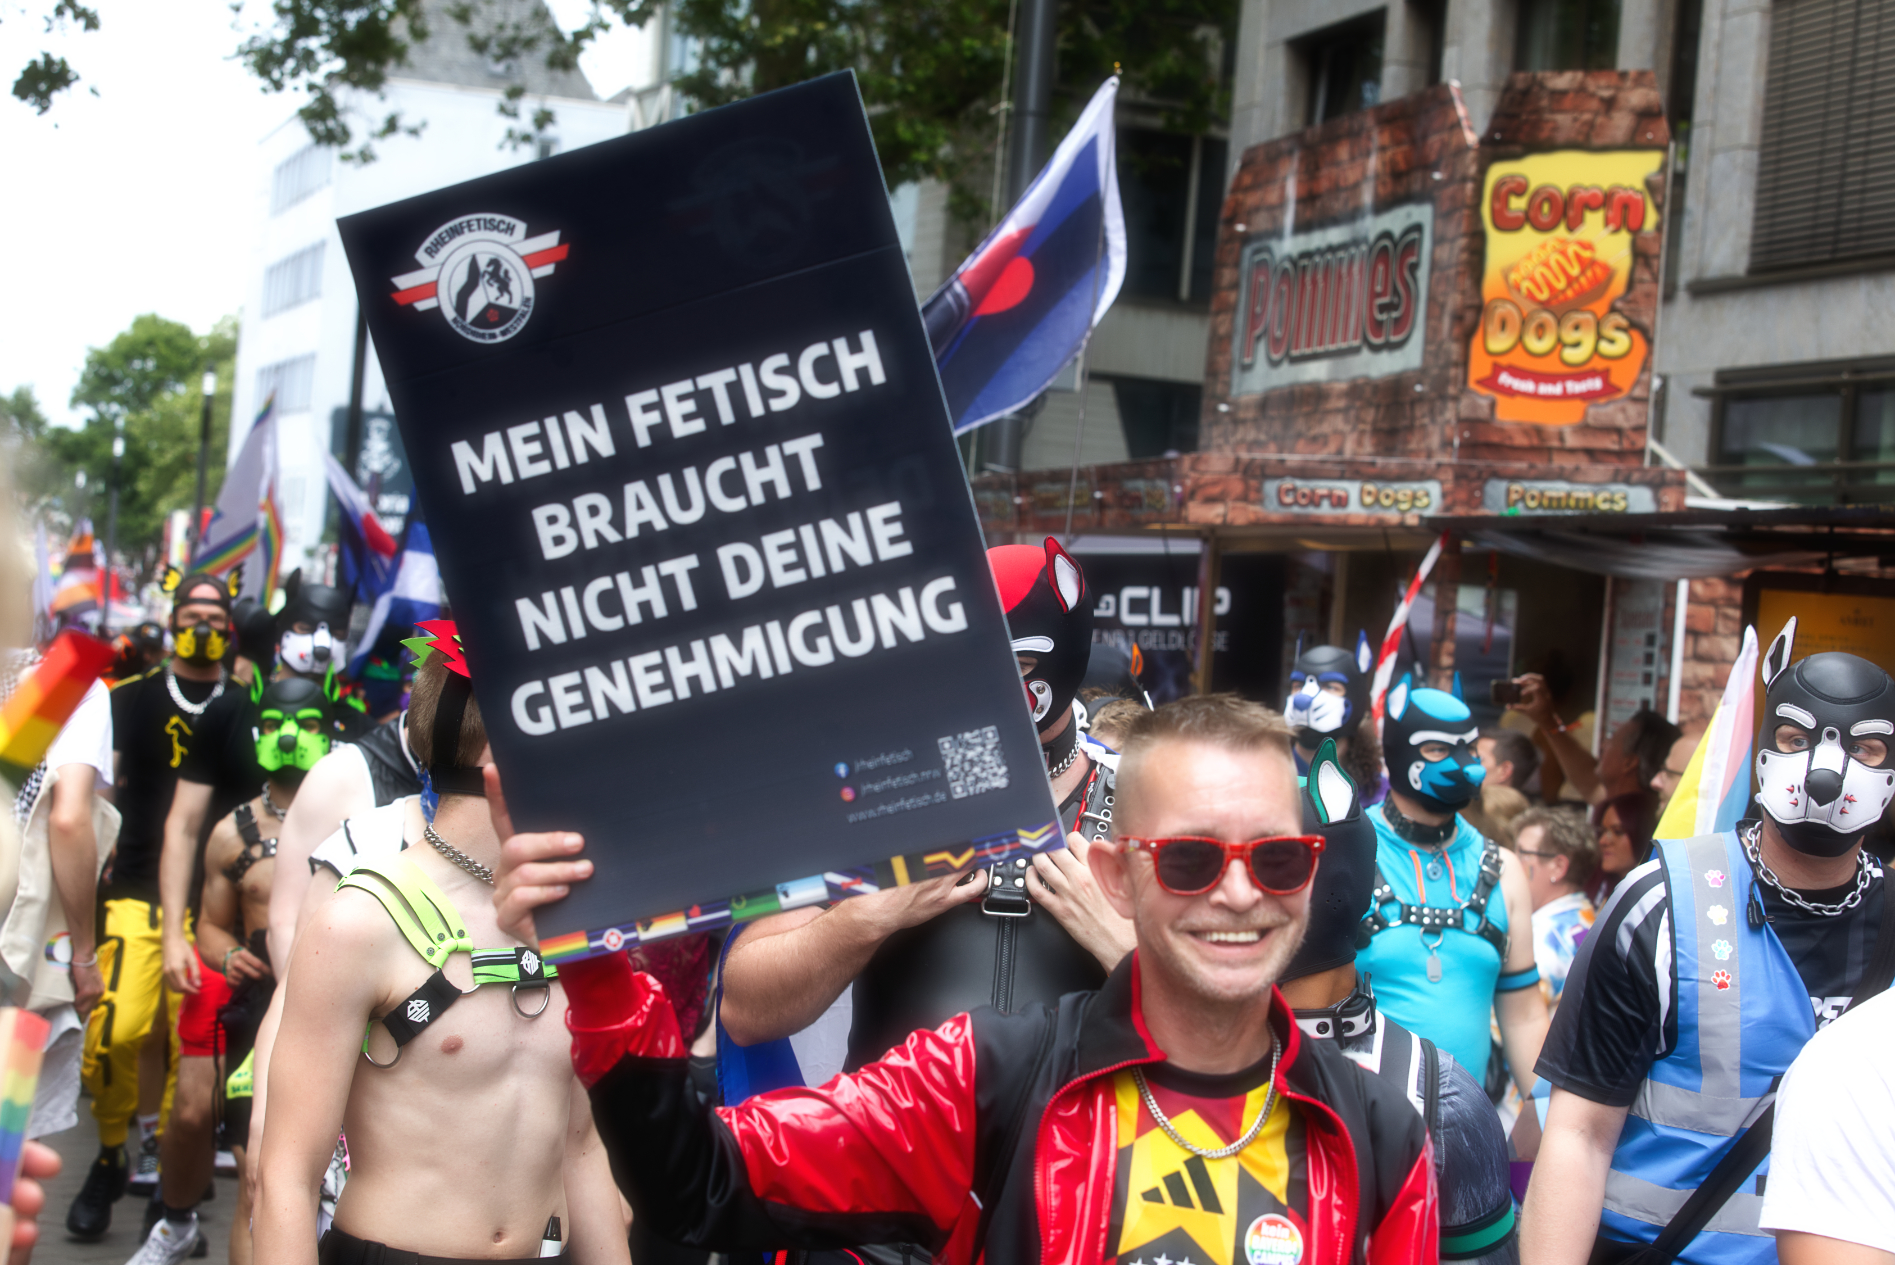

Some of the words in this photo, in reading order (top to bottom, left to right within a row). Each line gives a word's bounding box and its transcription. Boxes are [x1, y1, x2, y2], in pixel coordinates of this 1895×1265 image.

[1490, 175, 1646, 232] Corn
[425, 218, 516, 259] RHEINFETISCH
[1483, 297, 1633, 365] Dogs
[451, 403, 616, 495] MEIN
[624, 329, 887, 448] FETISCH
[1497, 371, 1536, 394] Fresh
[1537, 380, 1563, 396] and
[531, 433, 824, 560] BRAUCHT
[1277, 480, 1350, 507] Corn
[1359, 480, 1431, 511] Dogs
[1506, 482, 1628, 512] Pommes
[515, 554, 700, 651] NICHT
[716, 501, 914, 600] DEINE
[511, 575, 968, 736] GENEHMIGUNG
[1261, 1222, 1290, 1239] kein
